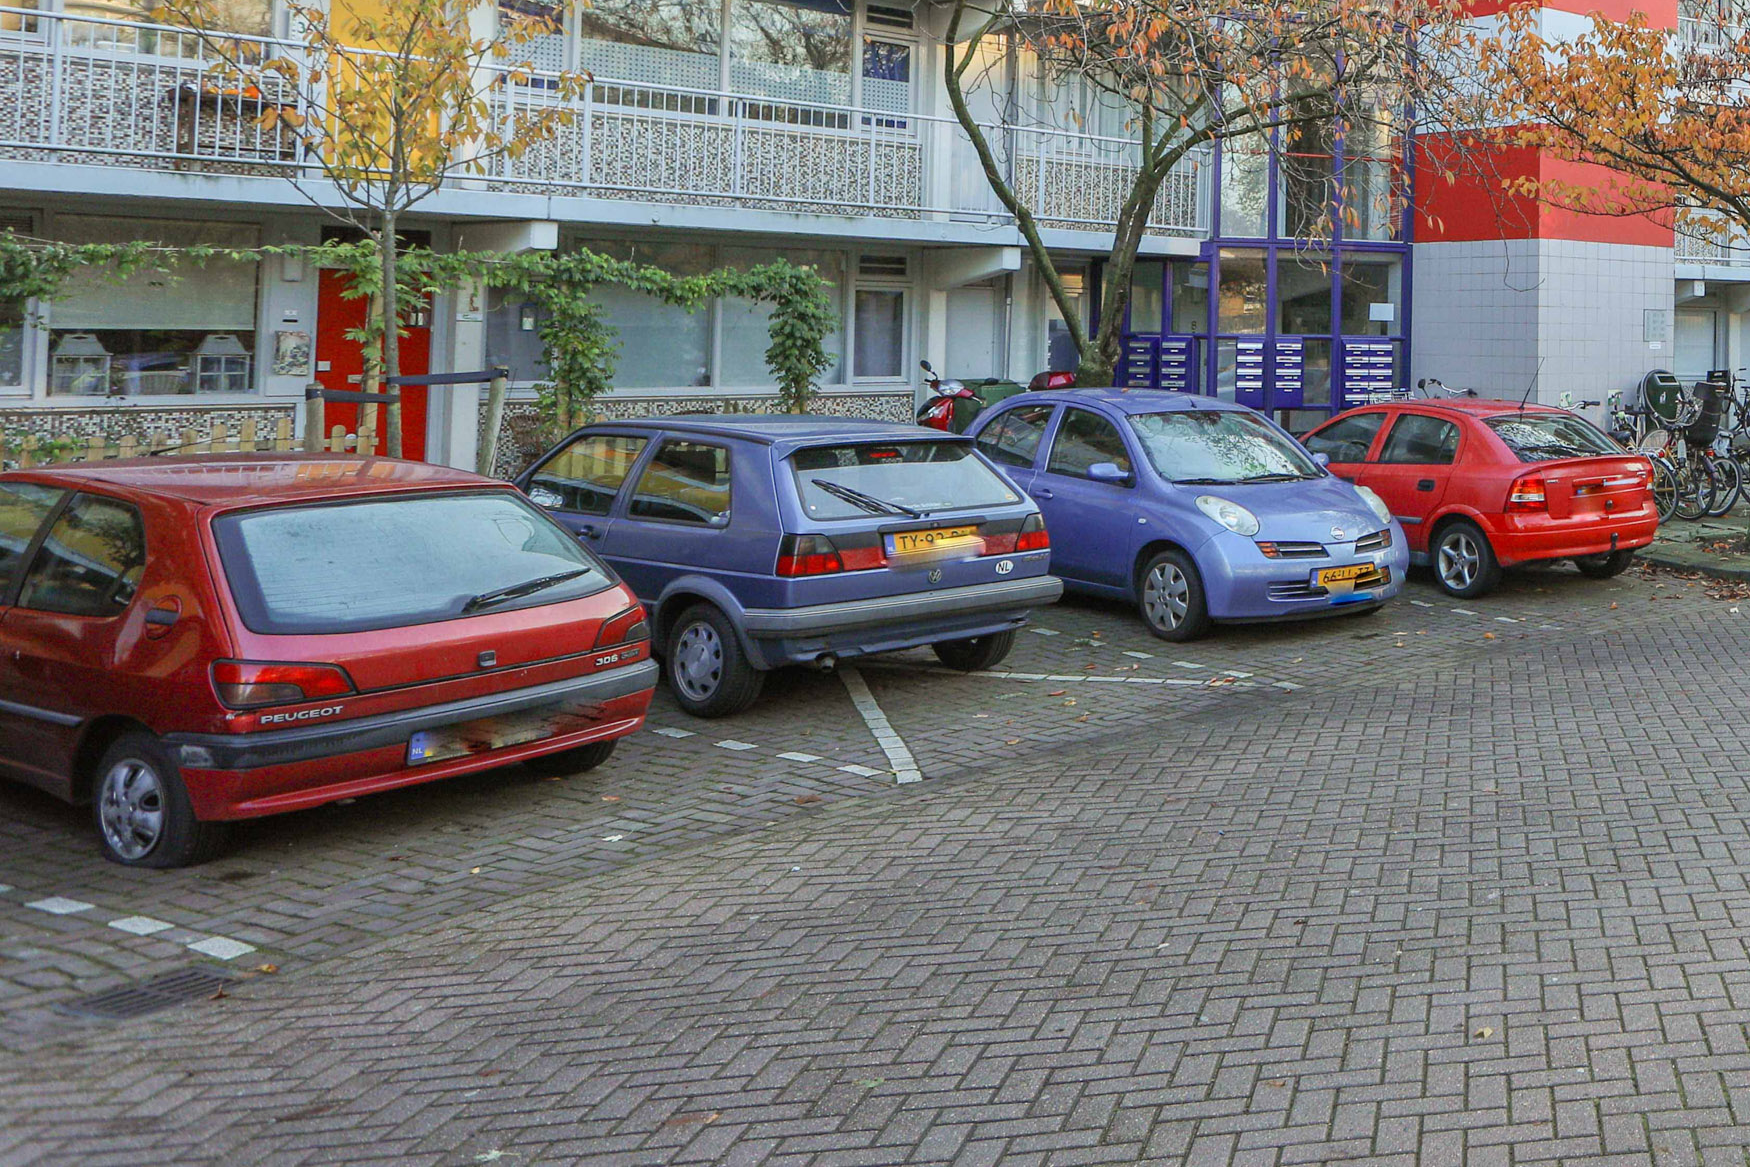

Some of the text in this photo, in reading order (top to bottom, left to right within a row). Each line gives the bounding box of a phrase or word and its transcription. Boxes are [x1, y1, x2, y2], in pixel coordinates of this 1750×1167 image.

[997, 562, 1010, 572] NL
[595, 654, 618, 666] 306
[260, 705, 344, 724] PEUGEOT
[411, 747, 424, 756] NL
